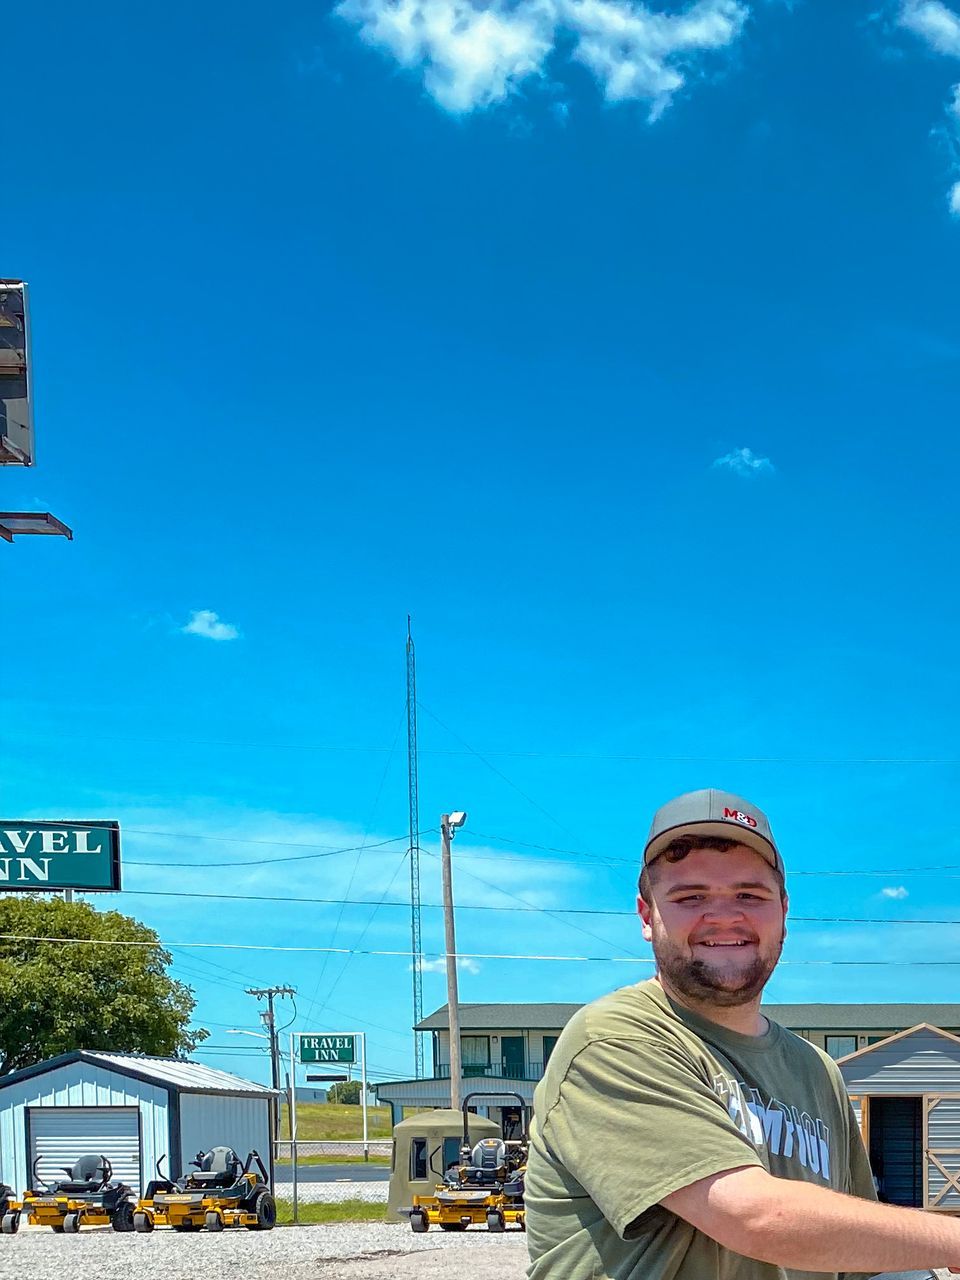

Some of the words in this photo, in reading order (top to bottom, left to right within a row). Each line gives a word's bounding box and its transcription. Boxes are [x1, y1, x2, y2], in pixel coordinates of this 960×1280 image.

[723, 807, 758, 828] M&D
[302, 1037, 352, 1049] TRAVEL
[314, 1049, 340, 1061] INN
